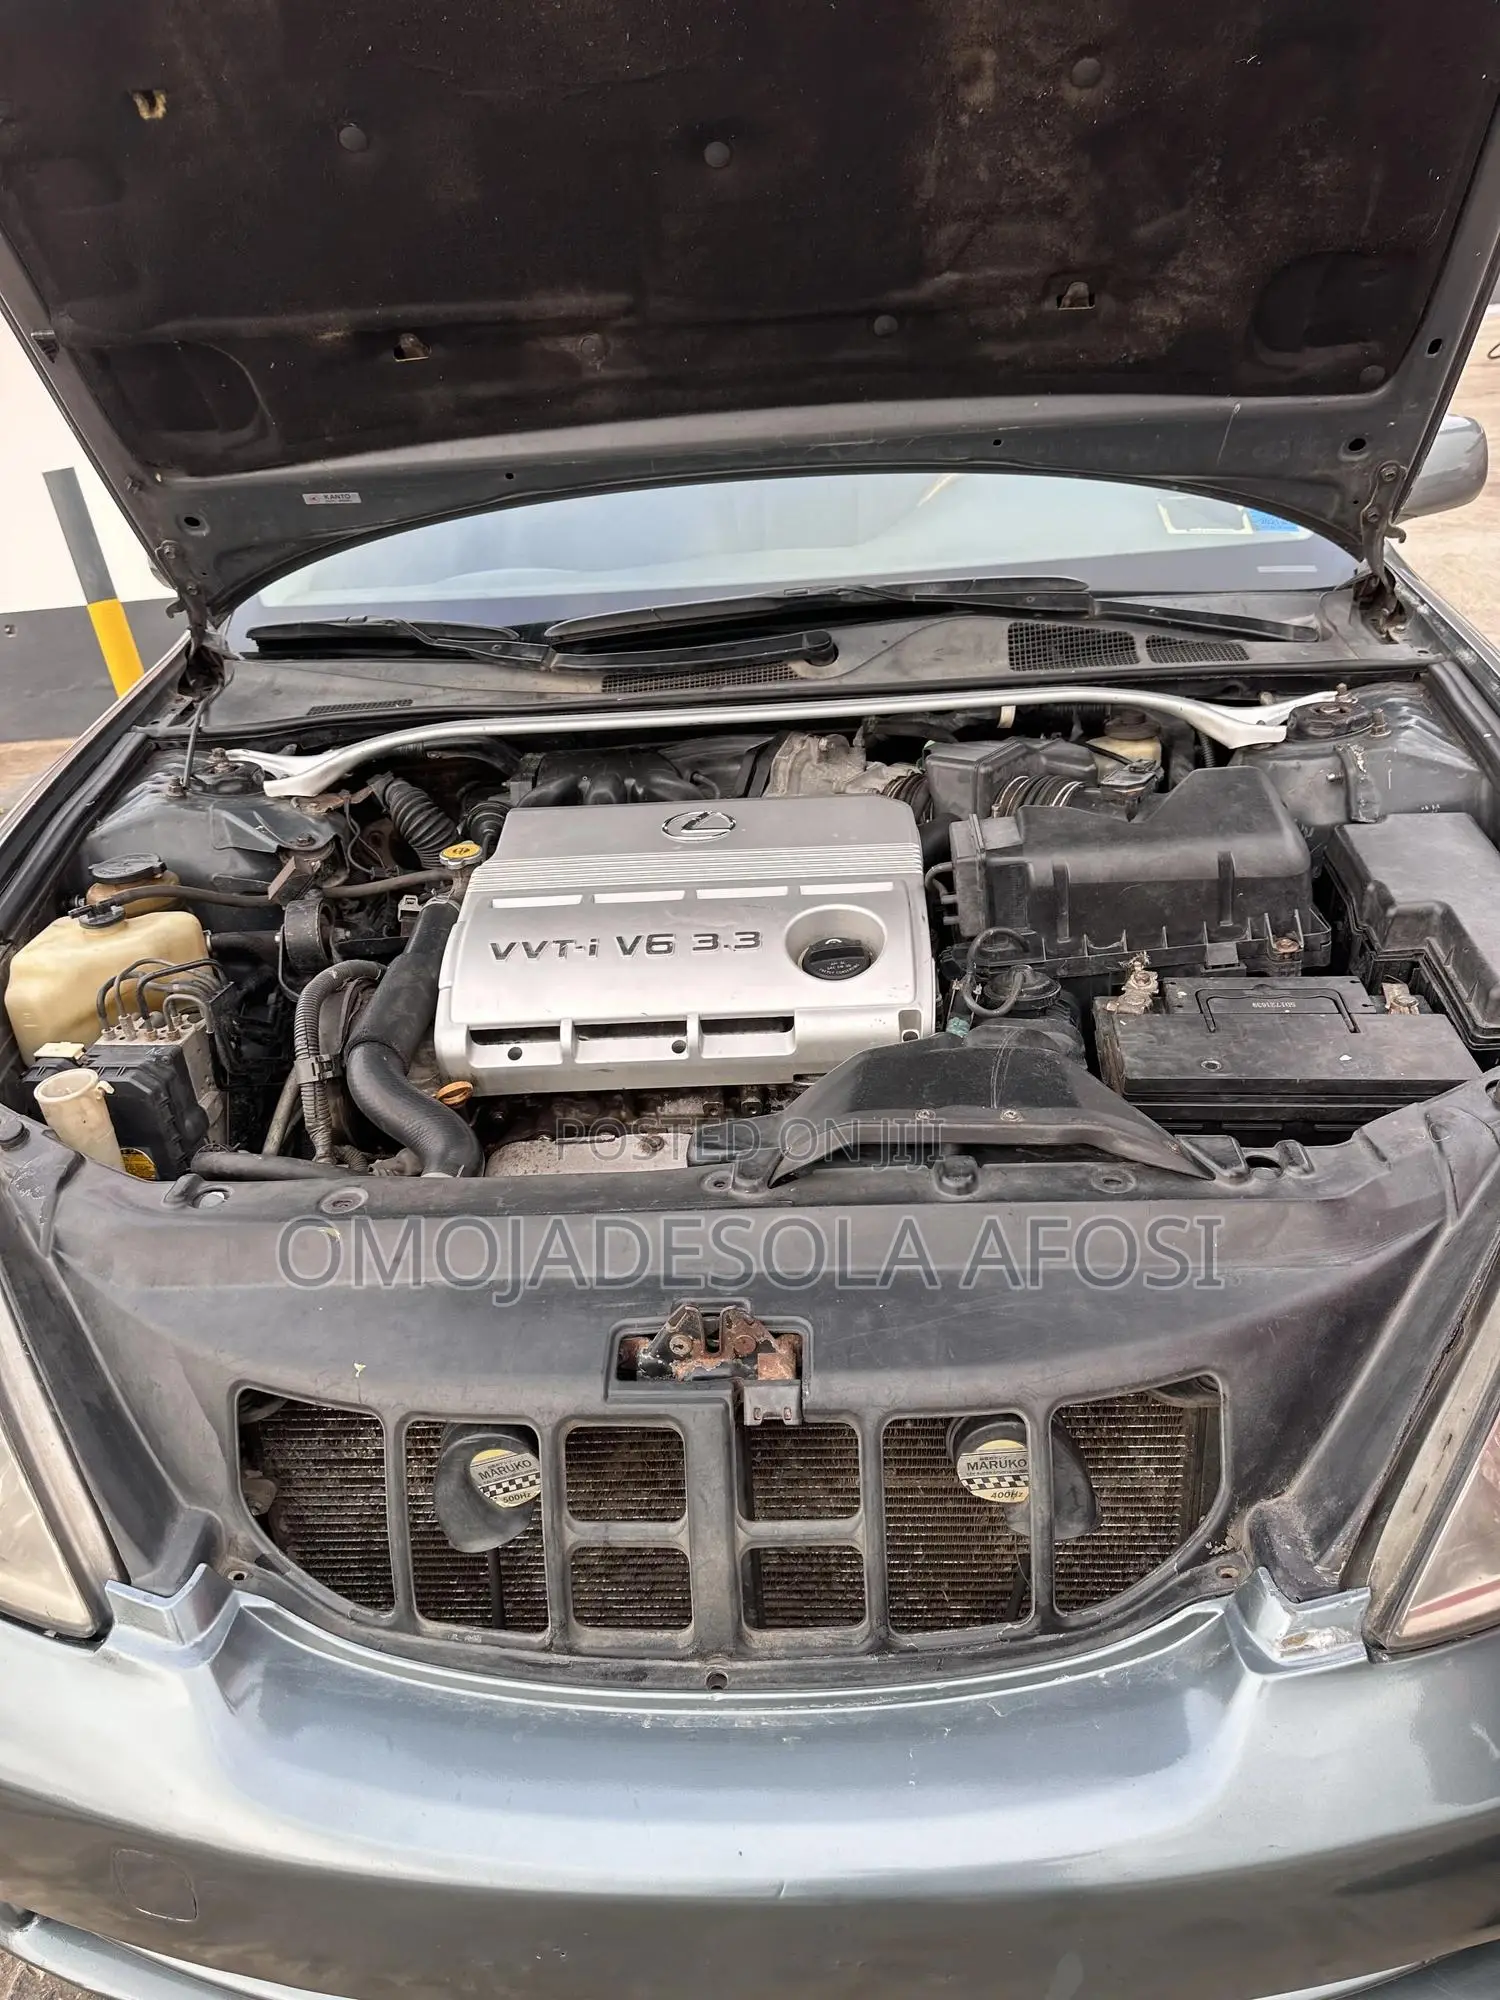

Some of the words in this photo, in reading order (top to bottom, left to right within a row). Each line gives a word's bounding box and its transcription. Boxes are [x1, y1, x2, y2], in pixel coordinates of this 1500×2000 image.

[489, 937, 600, 962] VVT-i
[615, 932, 676, 957] V6
[691, 930, 763, 952] 3.3
[478, 1459, 532, 1480] MARUKO
[966, 1458, 1027, 1472] MARUKO
[503, 1491, 531, 1504] 500Hz
[990, 1488, 1023, 1500] 400Hz
